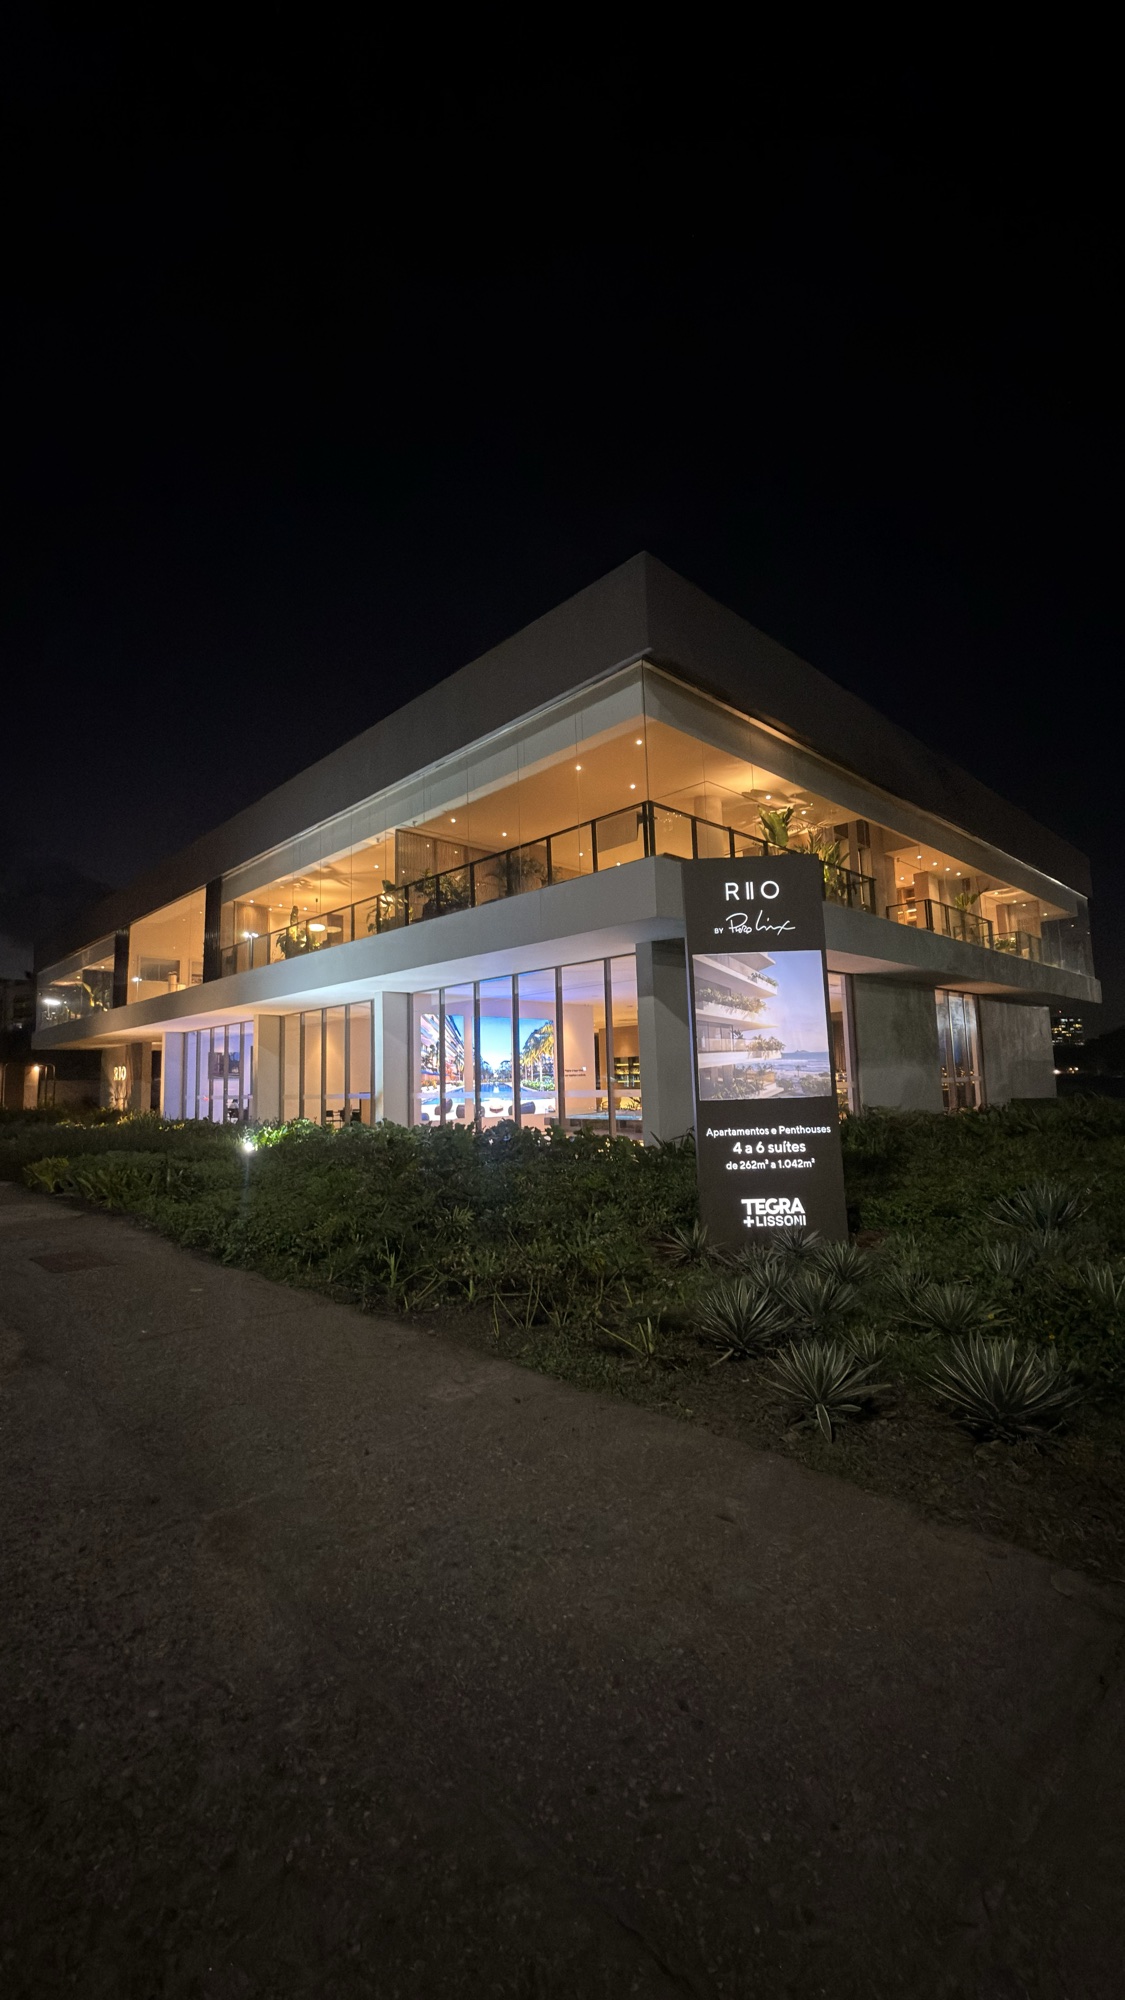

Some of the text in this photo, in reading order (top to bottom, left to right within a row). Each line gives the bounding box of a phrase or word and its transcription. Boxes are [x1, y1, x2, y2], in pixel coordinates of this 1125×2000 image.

[706, 1125, 832, 1138] Apartamentos e Penthouses
[732, 1140, 807, 1155] 4 a 6 suítes
[725, 1161, 739, 1170] de
[770, 1161, 777, 1169] a
[740, 1197, 806, 1215] TEGRA
